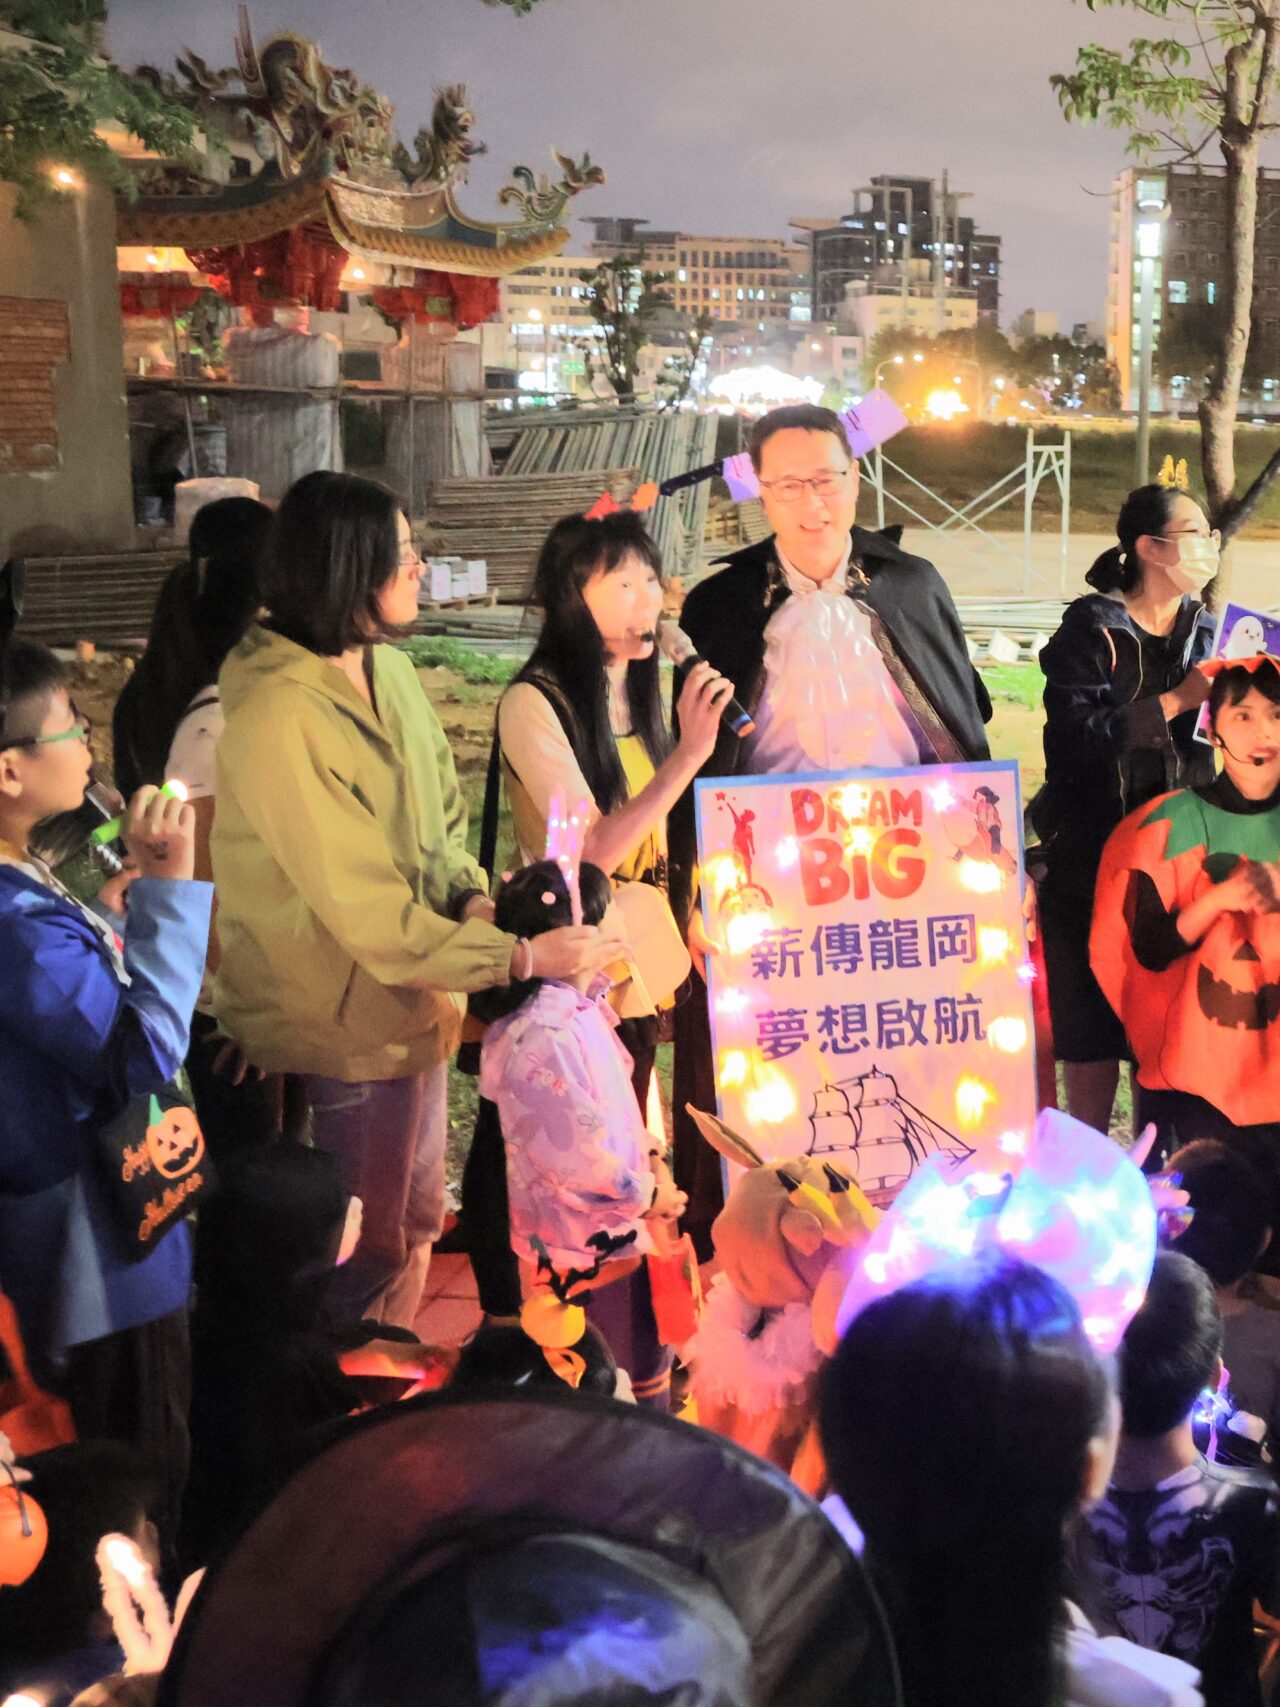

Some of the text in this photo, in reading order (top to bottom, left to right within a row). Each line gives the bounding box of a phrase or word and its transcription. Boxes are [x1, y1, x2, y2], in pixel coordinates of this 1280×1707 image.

[751, 914, 977, 980] 薪傳龍岡
[755, 993, 986, 1062] 夢想啟航
